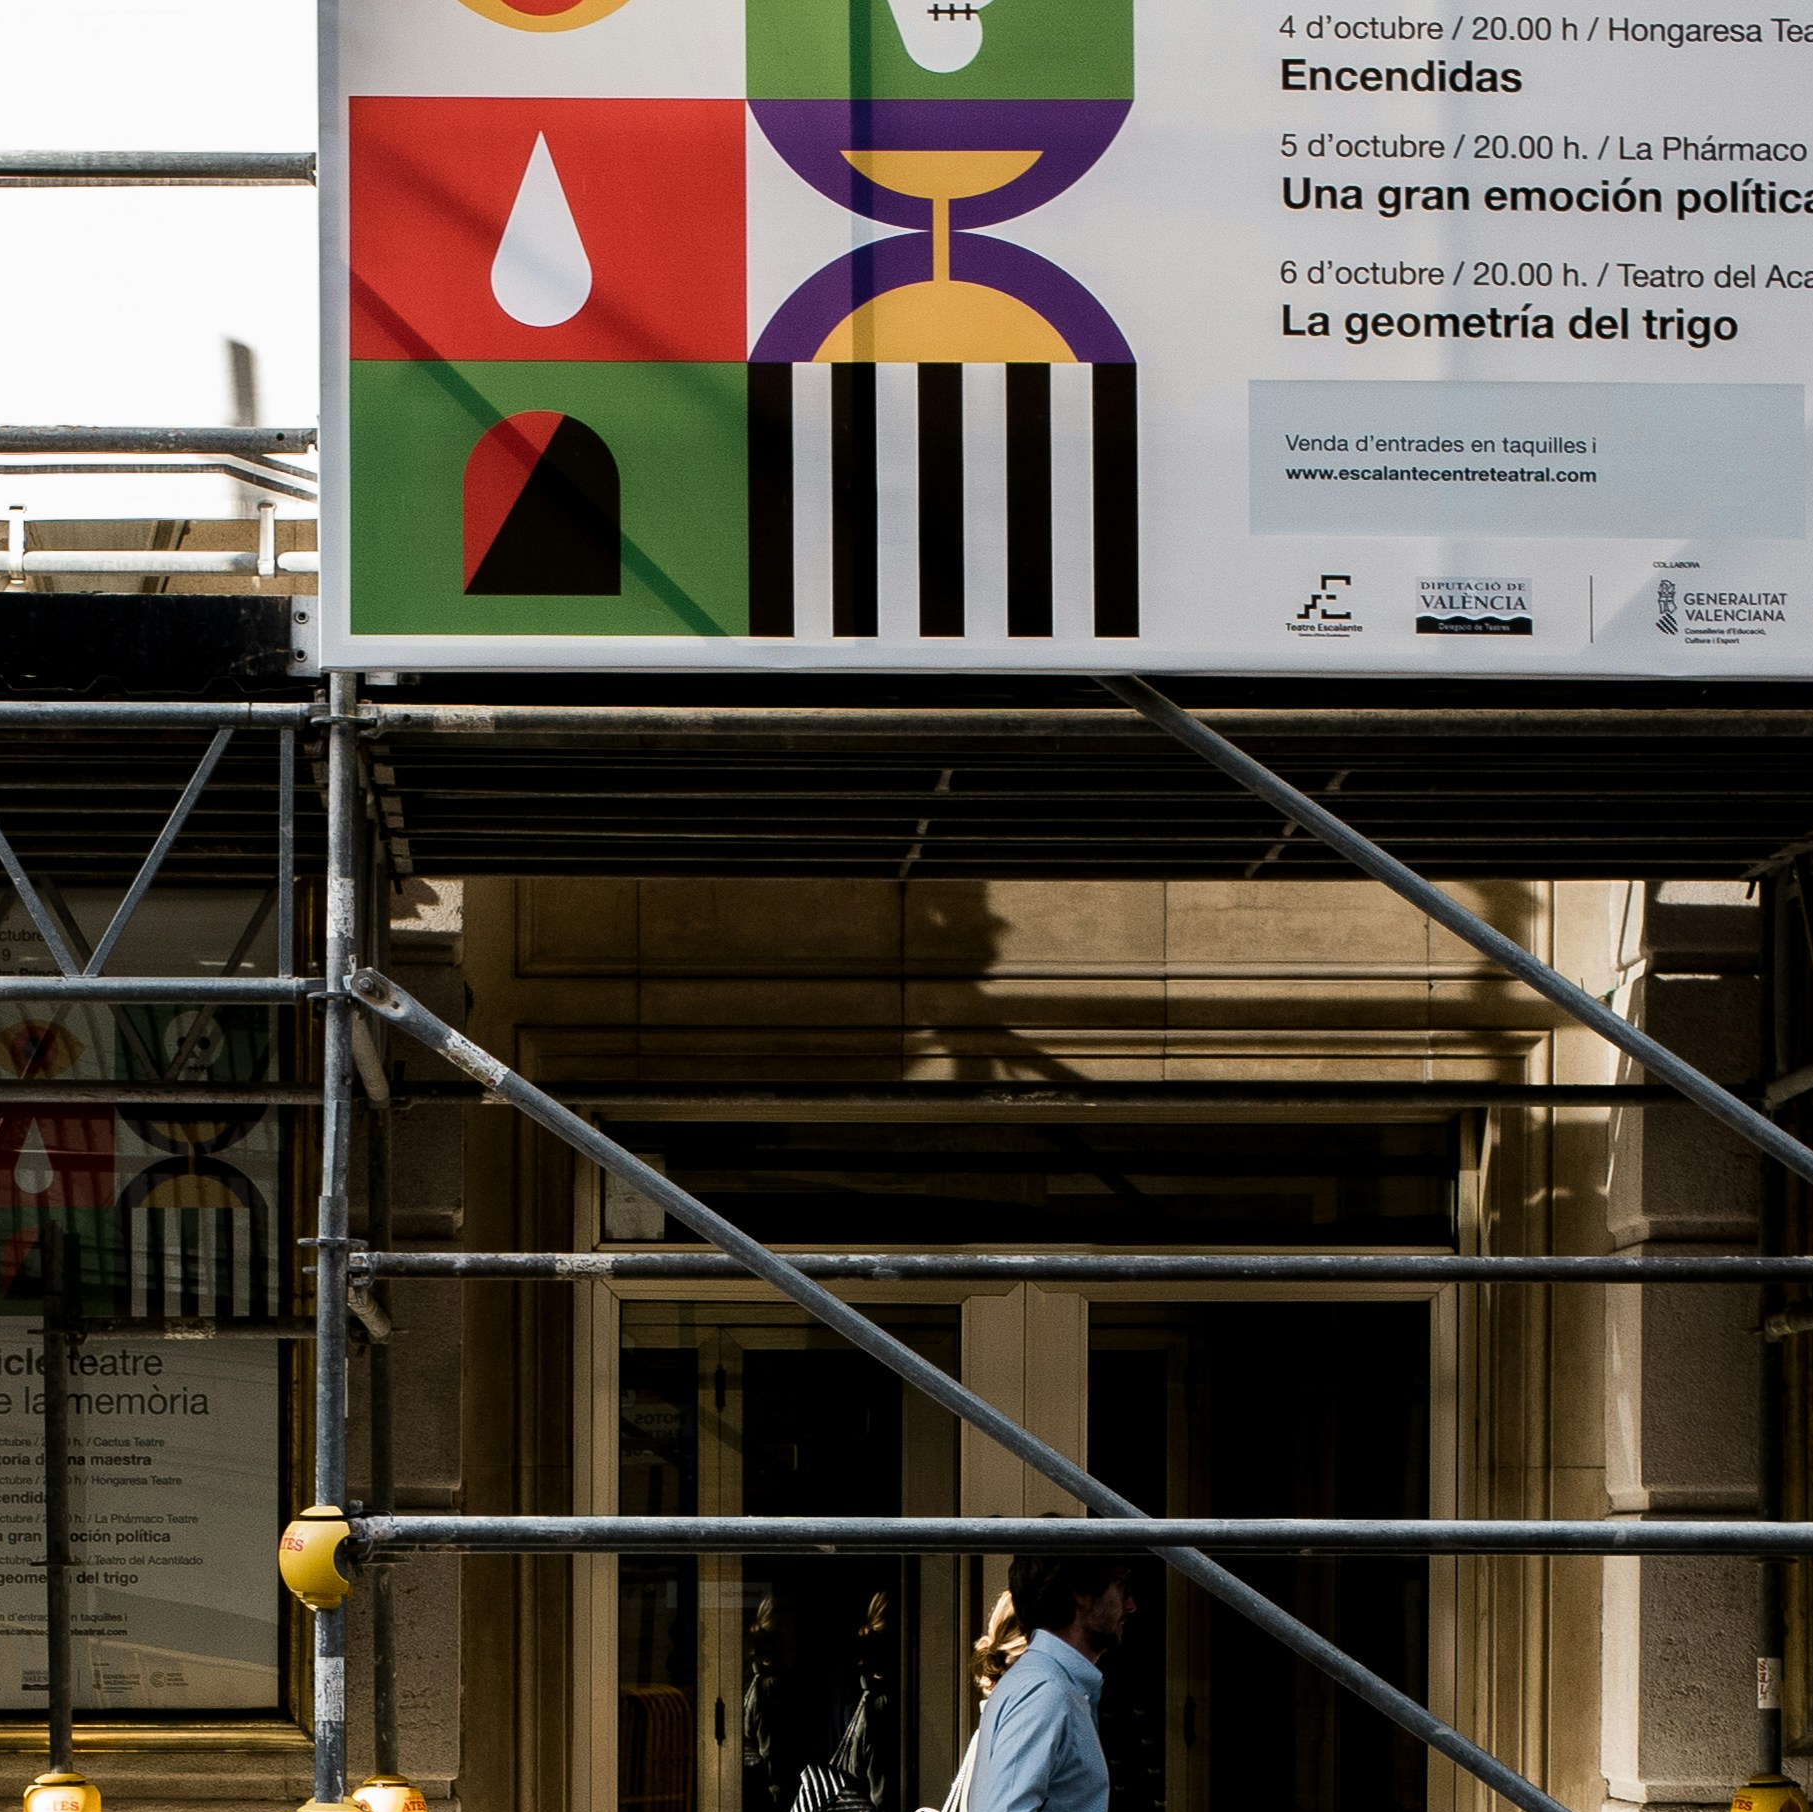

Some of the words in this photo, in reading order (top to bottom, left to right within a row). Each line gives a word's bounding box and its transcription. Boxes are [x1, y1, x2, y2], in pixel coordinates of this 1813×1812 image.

[1278, 14, 1297, 39] 4
[1305, 14, 1445, 41] d’octubre
[1471, 15, 1552, 42] 20.00
[1561, 16, 1579, 42] h
[1608, 16, 1764, 49] Hongaresa
[1280, 58, 1523, 94] Encendidas
[1280, 132, 1298, 158] 5
[1306, 132, 1446, 159] d’octubre
[1472, 134, 1554, 160] 20.00
[1563, 134, 1589, 160] h.
[1618, 135, 1655, 161] La
[1662, 134, 1808, 162] Phármaco
[1282, 176, 1364, 211] Una
[1377, 185, 1471, 219] gran
[1483, 176, 1663, 214] emoción
[1279, 259, 1298, 285] 6
[1306, 259, 1446, 286] d’octubre
[1472, 261, 1554, 287] 20.00
[1562, 262, 1588, 288] h.
[1615, 262, 1705, 289] Teatro
[1713, 263, 1756, 289] del
[1281, 303, 1331, 337] La
[1344, 302, 1555, 346] geometría
[1567, 306, 1630, 340] del
[1641, 307, 1739, 349] trigo
[1284, 433, 1350, 453] Venda
[1355, 434, 1465, 454] d’entrades
[1470, 439, 1496, 454] en
[1500, 436, 1588, 458] taquilles
[1591, 436, 1597, 454] i
[1284, 464, 1598, 484] www.escalantecentreteatral.com
[1420, 581, 1501, 591] DIPUTACIÓ
[1507, 583, 1526, 591] DE
[1420, 592, 1527, 611] VALÈNCIA
[1683, 593, 1788, 606] GENERALITAT
[1685, 609, 1785, 622] VALENCIANA
[1318, 623, 1363, 632] Escalante
[69, 1349, 163, 1375] teatre
[68, 1385, 209, 1415] memòria
[133, 1438, 164, 1446] Teatre
[68, 1455, 85, 1465] na
[90, 1454, 151, 1465] maestra
[91, 1476, 147, 1488] Hongaresa
[151, 1476, 182, 1485] Teatre
[95, 1514, 108, 1523] La
[166, 1514, 199, 1523] Teatre
[8, 1532, 41, 1545] gran
[70, 1529, 111, 1543] oción
[116, 1528, 170, 1545] política
[130, 1555, 145, 1565] del
[77, 1571, 98, 1584] del
[104, 1572, 138, 1587] trigo
